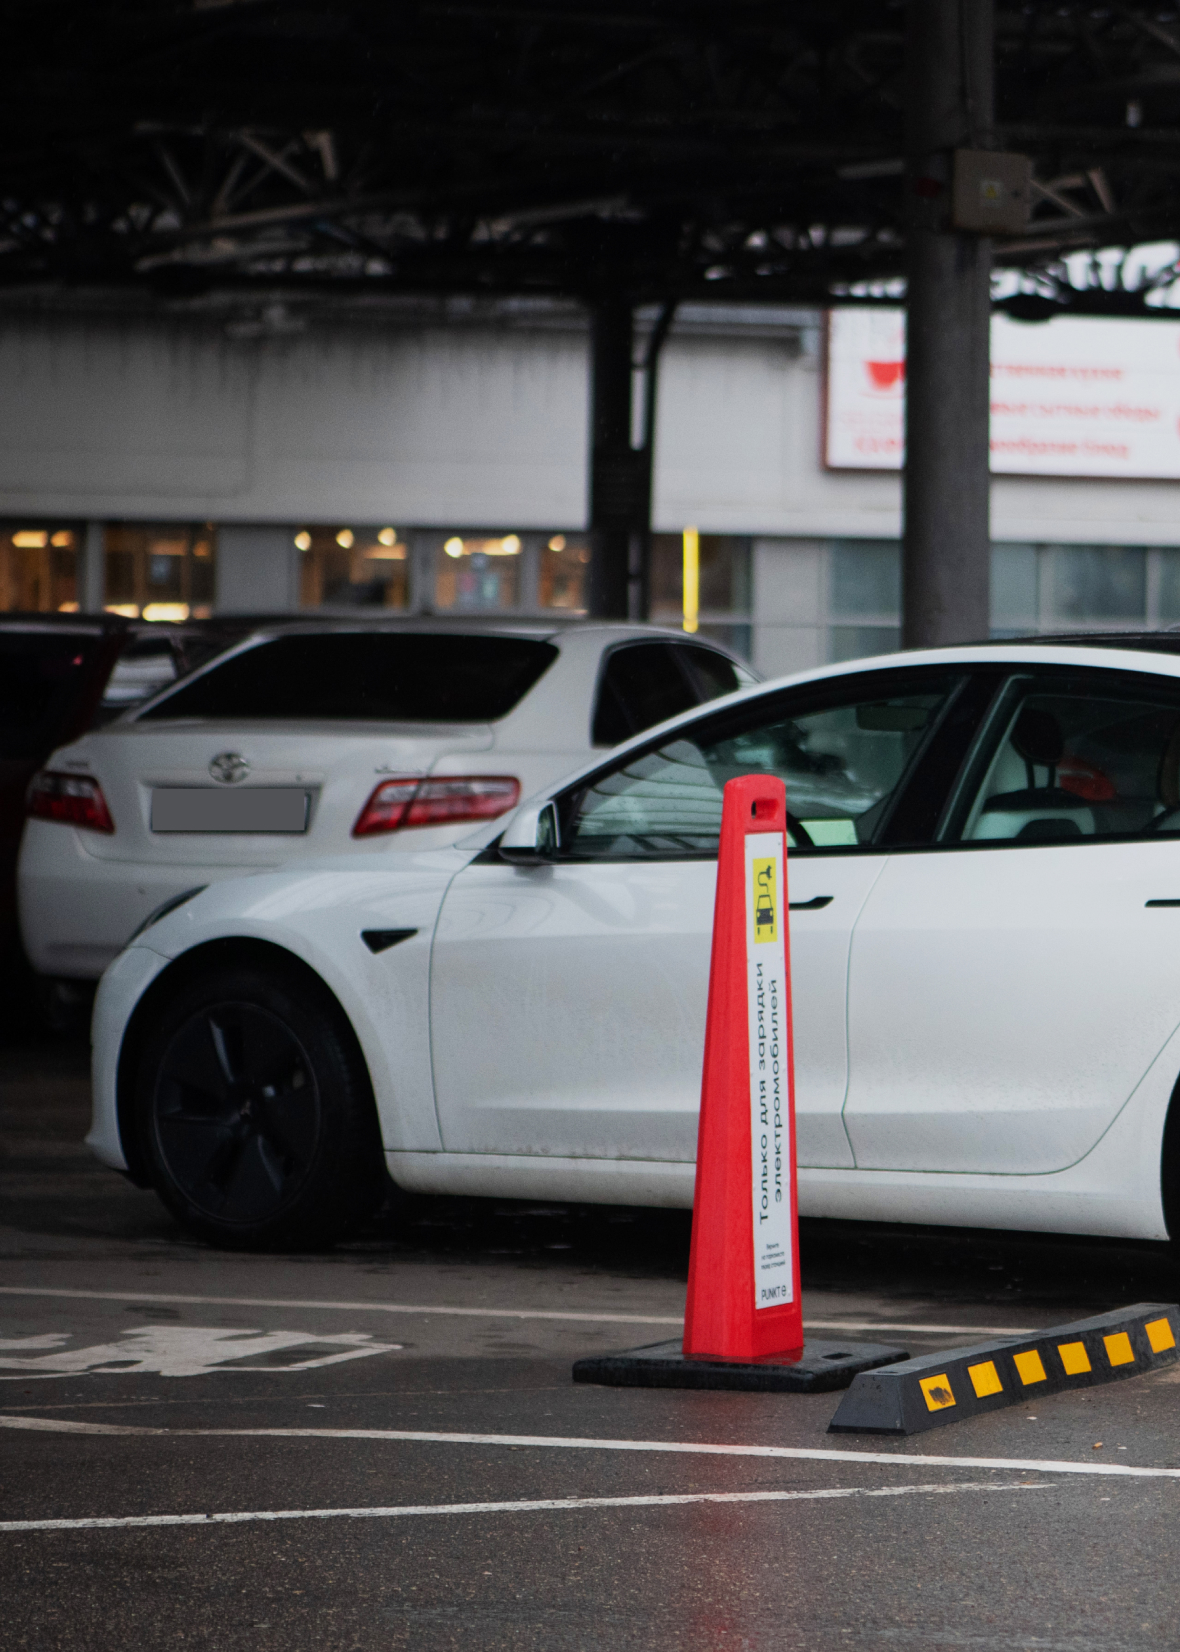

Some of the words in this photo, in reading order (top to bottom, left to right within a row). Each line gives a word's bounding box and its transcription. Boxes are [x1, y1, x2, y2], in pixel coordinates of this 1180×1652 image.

[756, 963, 767, 1071] зарядки
[760, 1080, 769, 1126] для
[768, 979, 783, 1203] электромобилей
[760, 1134, 768, 1225] Только
[761, 1286, 781, 1301] PUNKT
